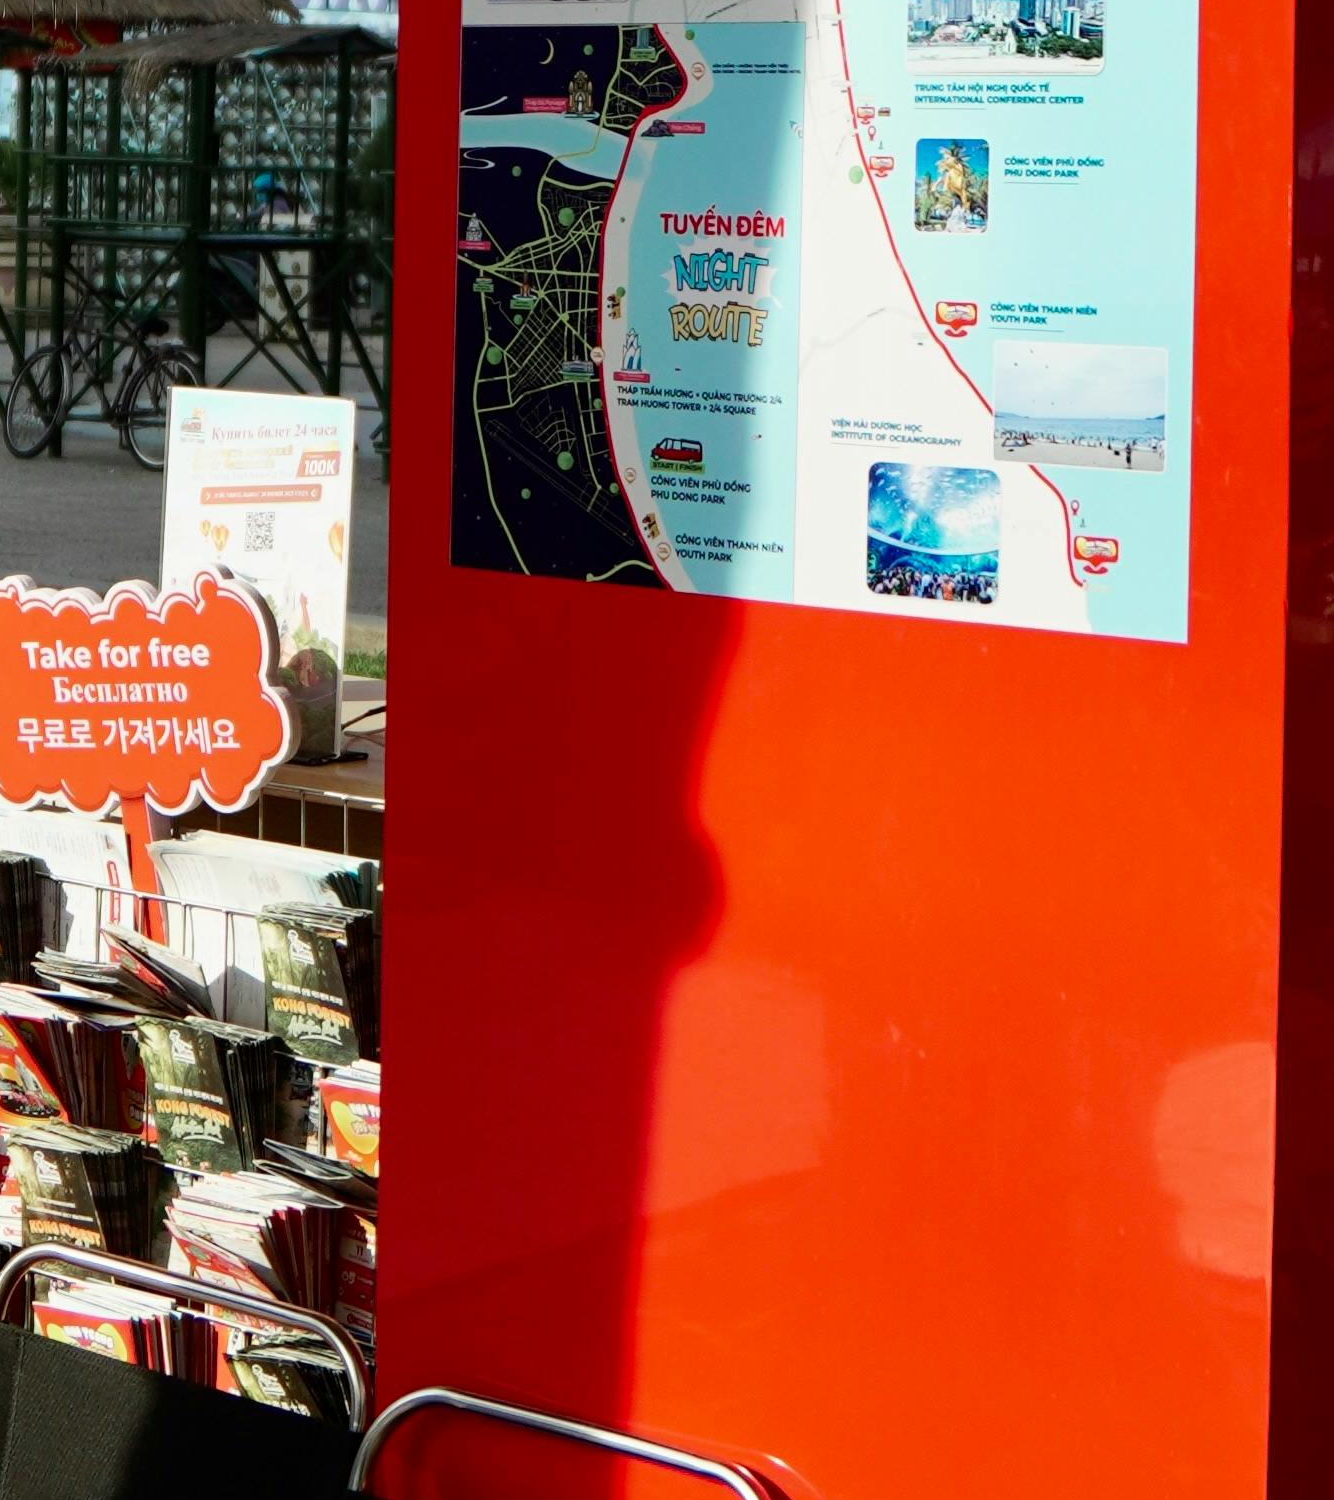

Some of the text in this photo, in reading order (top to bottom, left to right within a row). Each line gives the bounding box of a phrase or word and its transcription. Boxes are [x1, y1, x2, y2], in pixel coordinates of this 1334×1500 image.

[915, 83, 944, 93] TRUNG
[915, 95, 1084, 105] INTERNATIONAL CONFERENCE CENTER
[1004, 169, 1080, 178] PHU DONG PARK
[660, 204, 784, 237] TUYẾN ĐÊM
[674, 248, 769, 294] NIGHT
[1041, 305, 1073, 314] THANH
[668, 301, 768, 346] ROUTE
[990, 315, 1047, 325] YOUTH PARK
[617, 397, 756, 416] TRAM HUONG TOWER 2/4 SQUARE
[212, 427, 254, 441] Купить
[257, 425, 290, 439] билет
[294, 424, 307, 437] 24
[311, 424, 338, 436] часа
[831, 430, 963, 447] INSTITUTE OF OCEANOGRAPHY
[304, 459, 338, 475] 100K
[651, 474, 676, 486] CÔNG
[678, 476, 700, 488] VIÊN
[651, 490, 725, 505] PHU DONG PARK
[675, 534, 701, 546] CÔNG
[703, 536, 725, 548] VIÊN
[727, 539, 759, 551] THANH
[675, 548, 732, 562] YOUTH PARK
[21, 637, 210, 669] Take for free
[52, 677, 188, 703] Бесплатно
[17, 716, 241, 755] 무료로 가져가세요
